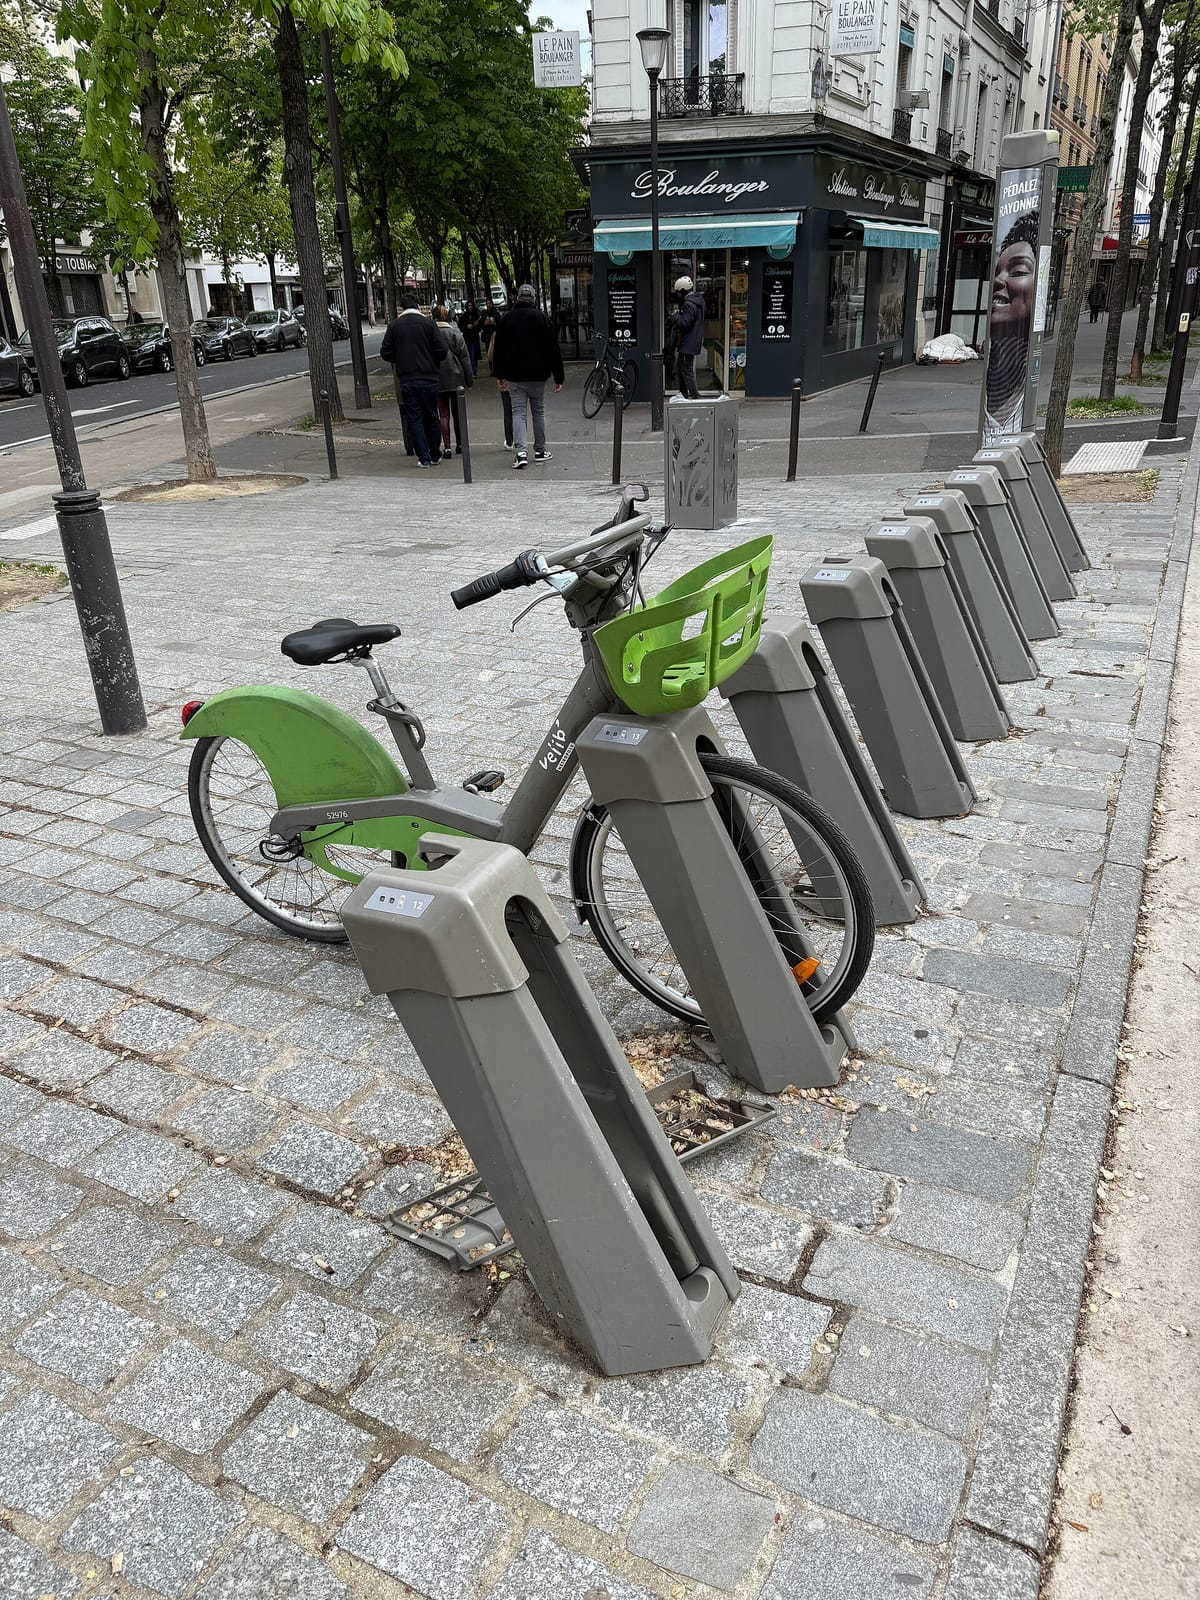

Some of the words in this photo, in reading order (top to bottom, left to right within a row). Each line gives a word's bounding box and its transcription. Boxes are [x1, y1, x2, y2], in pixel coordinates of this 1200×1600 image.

[839, 2, 850, 16] LE
[852, 0, 875, 16] PAIN
[838, 15, 875, 29] BOULANGER
[538, 38, 549, 52] LE
[551, 37, 573, 52] PAIN
[539, 51, 574, 64] BOULANGER
[630, 168, 769, 203] Boulanger
[827, 167, 858, 197] Artisan
[1002, 178, 1038, 199] PÉDALEZ
[999, 195, 1039, 217] RAYONNEZ
[631, 732, 641, 741] 13
[412, 900, 424, 910] 12
